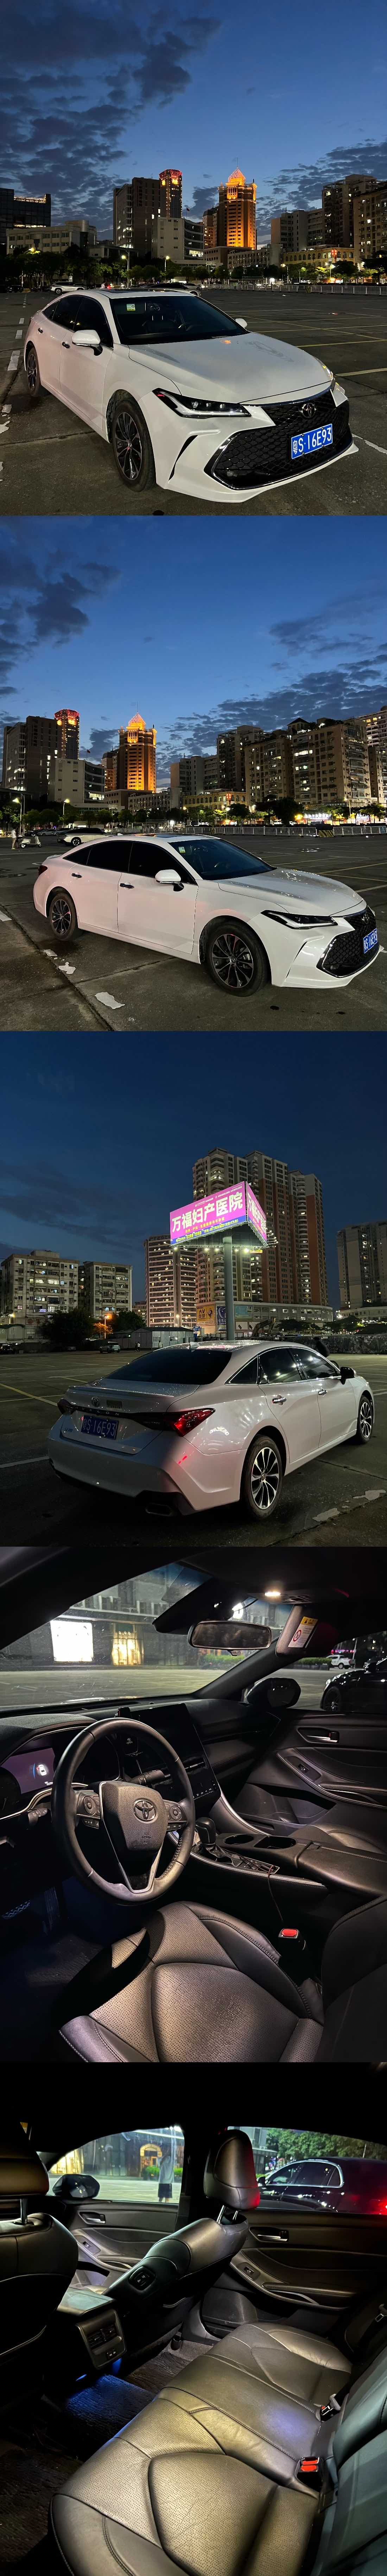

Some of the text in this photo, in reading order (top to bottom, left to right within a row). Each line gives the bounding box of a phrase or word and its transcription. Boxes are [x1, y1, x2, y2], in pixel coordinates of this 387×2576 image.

[172, 1192, 243, 1233] 万福妇产医院
